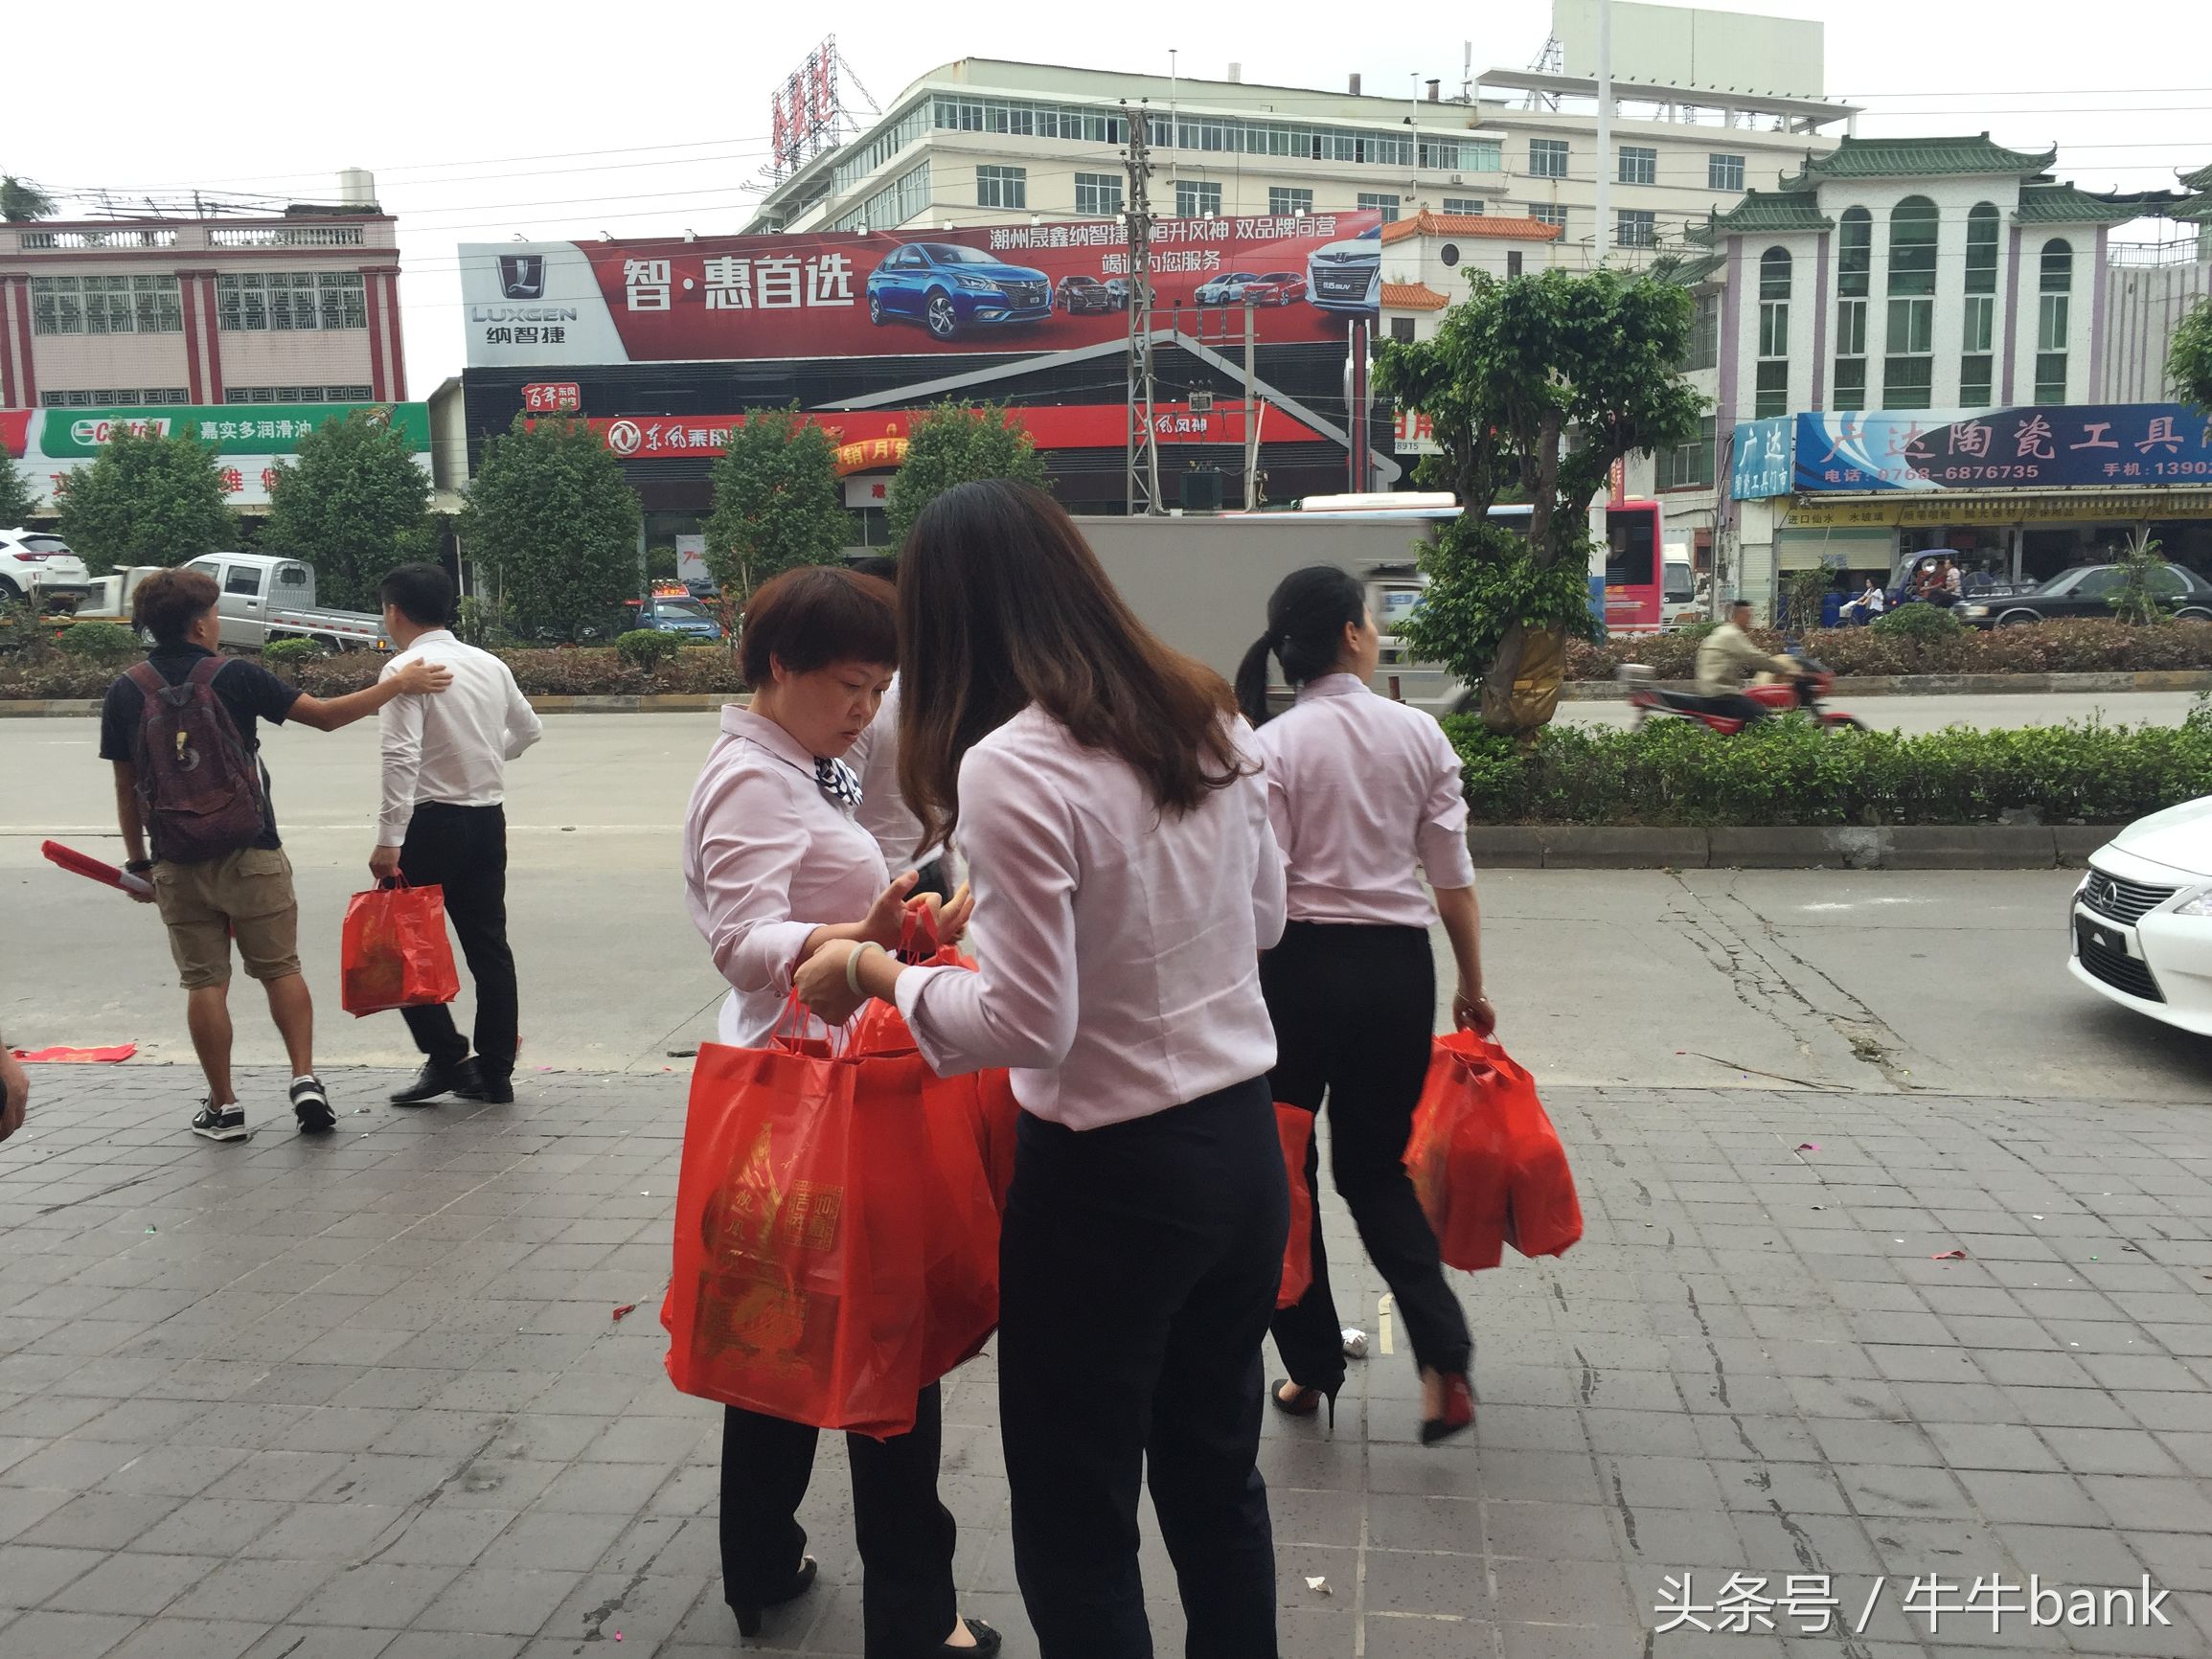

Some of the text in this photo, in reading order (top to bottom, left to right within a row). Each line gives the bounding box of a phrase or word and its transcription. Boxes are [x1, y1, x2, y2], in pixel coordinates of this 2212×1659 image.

[1235, 216, 1336, 239] 双品牌同营
[471, 306, 578, 323] LUXGEN
[486, 326, 566, 345] 纳智捷
[199, 420, 312, 440] 嘉实多润滑油
[646, 422, 734, 451] 东风乘用
[1394, 442, 1419, 450] 8915
